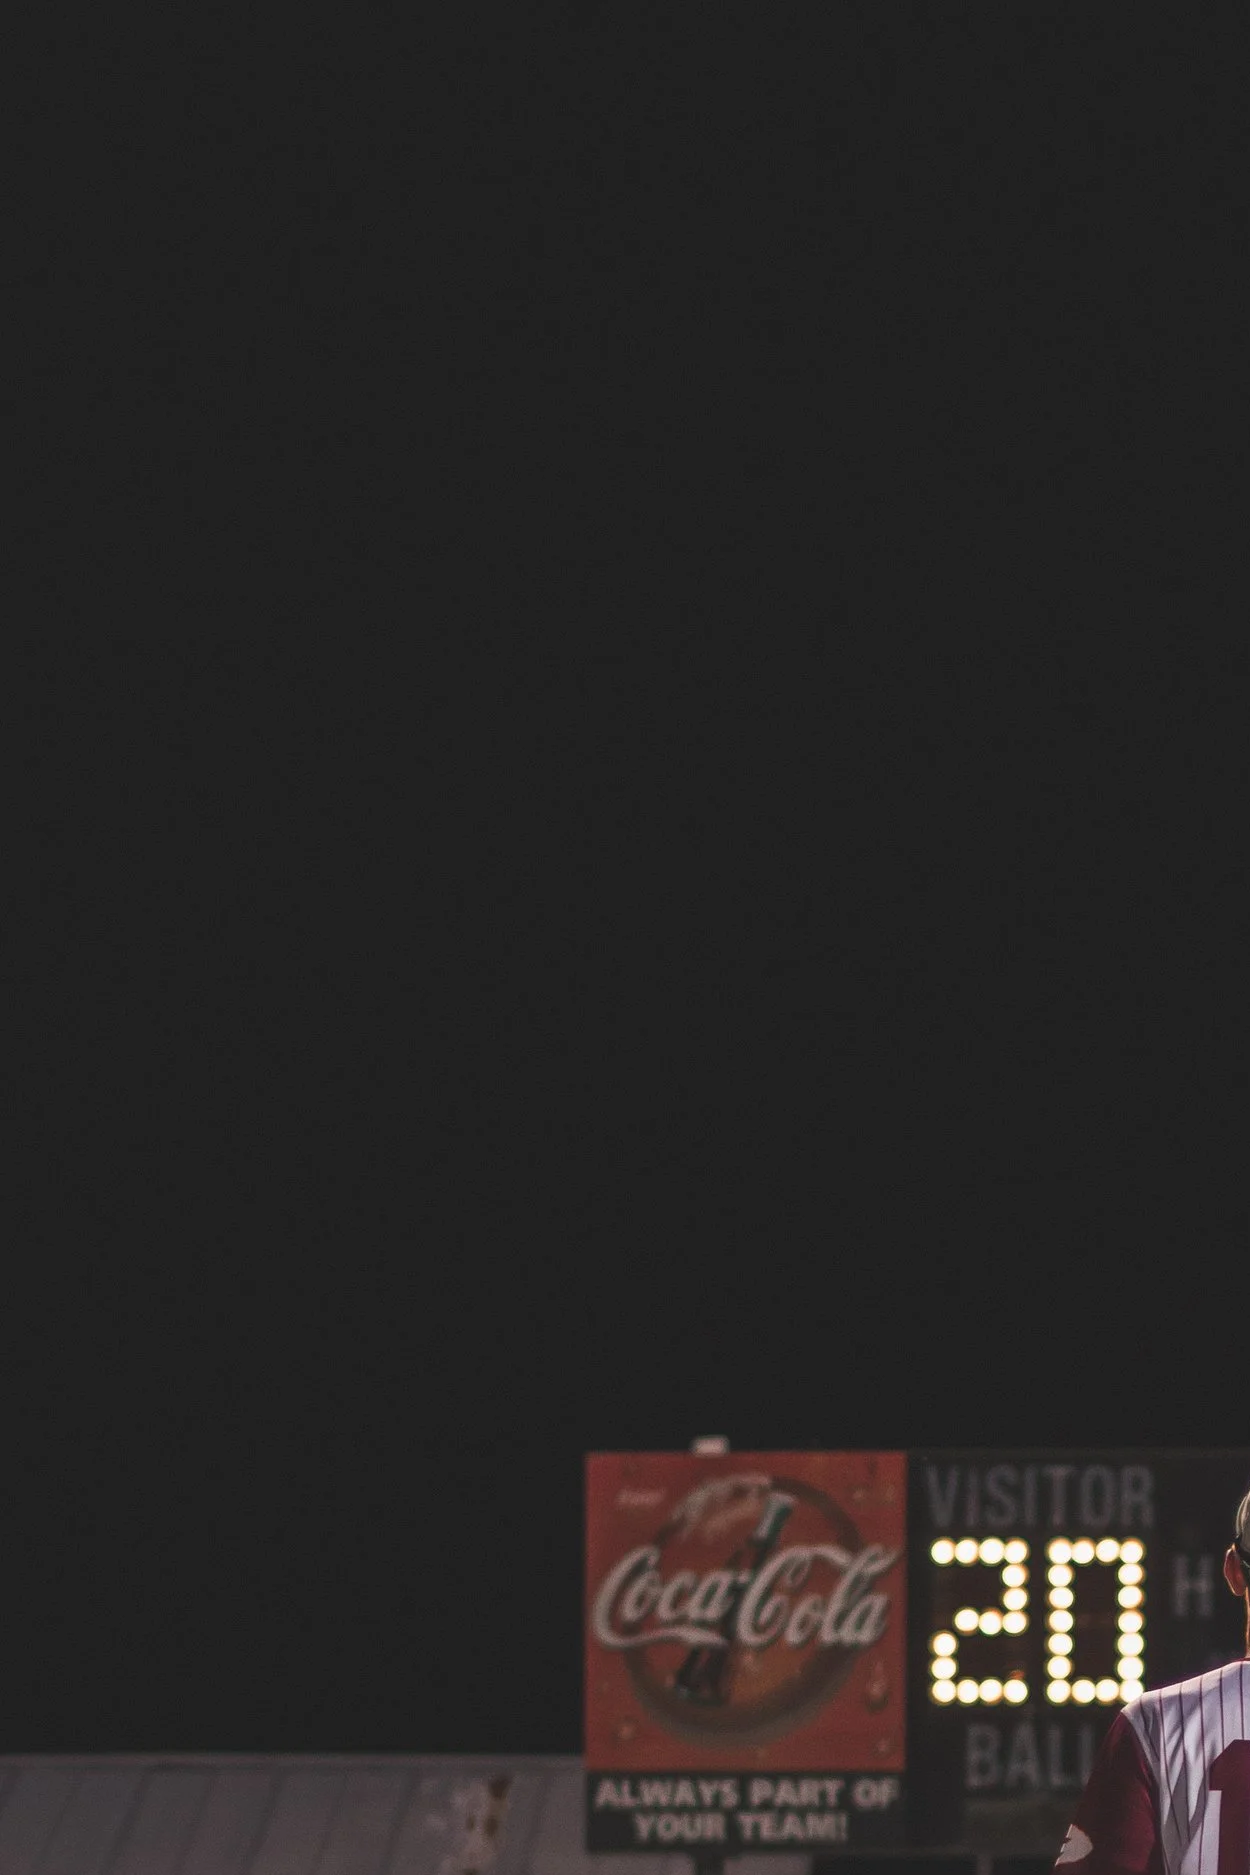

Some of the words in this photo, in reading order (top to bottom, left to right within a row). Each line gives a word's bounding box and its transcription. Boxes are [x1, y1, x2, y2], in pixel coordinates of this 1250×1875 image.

[925, 1464, 1155, 1528] VISITOR
[930, 1537, 1146, 1705] 20
[596, 1777, 740, 1808] ALWAYS
[749, 1778, 845, 1807] PART
[853, 1777, 897, 1809] OF
[633, 1812, 727, 1842] YOUR
[737, 1812, 848, 1842] TEAM!
